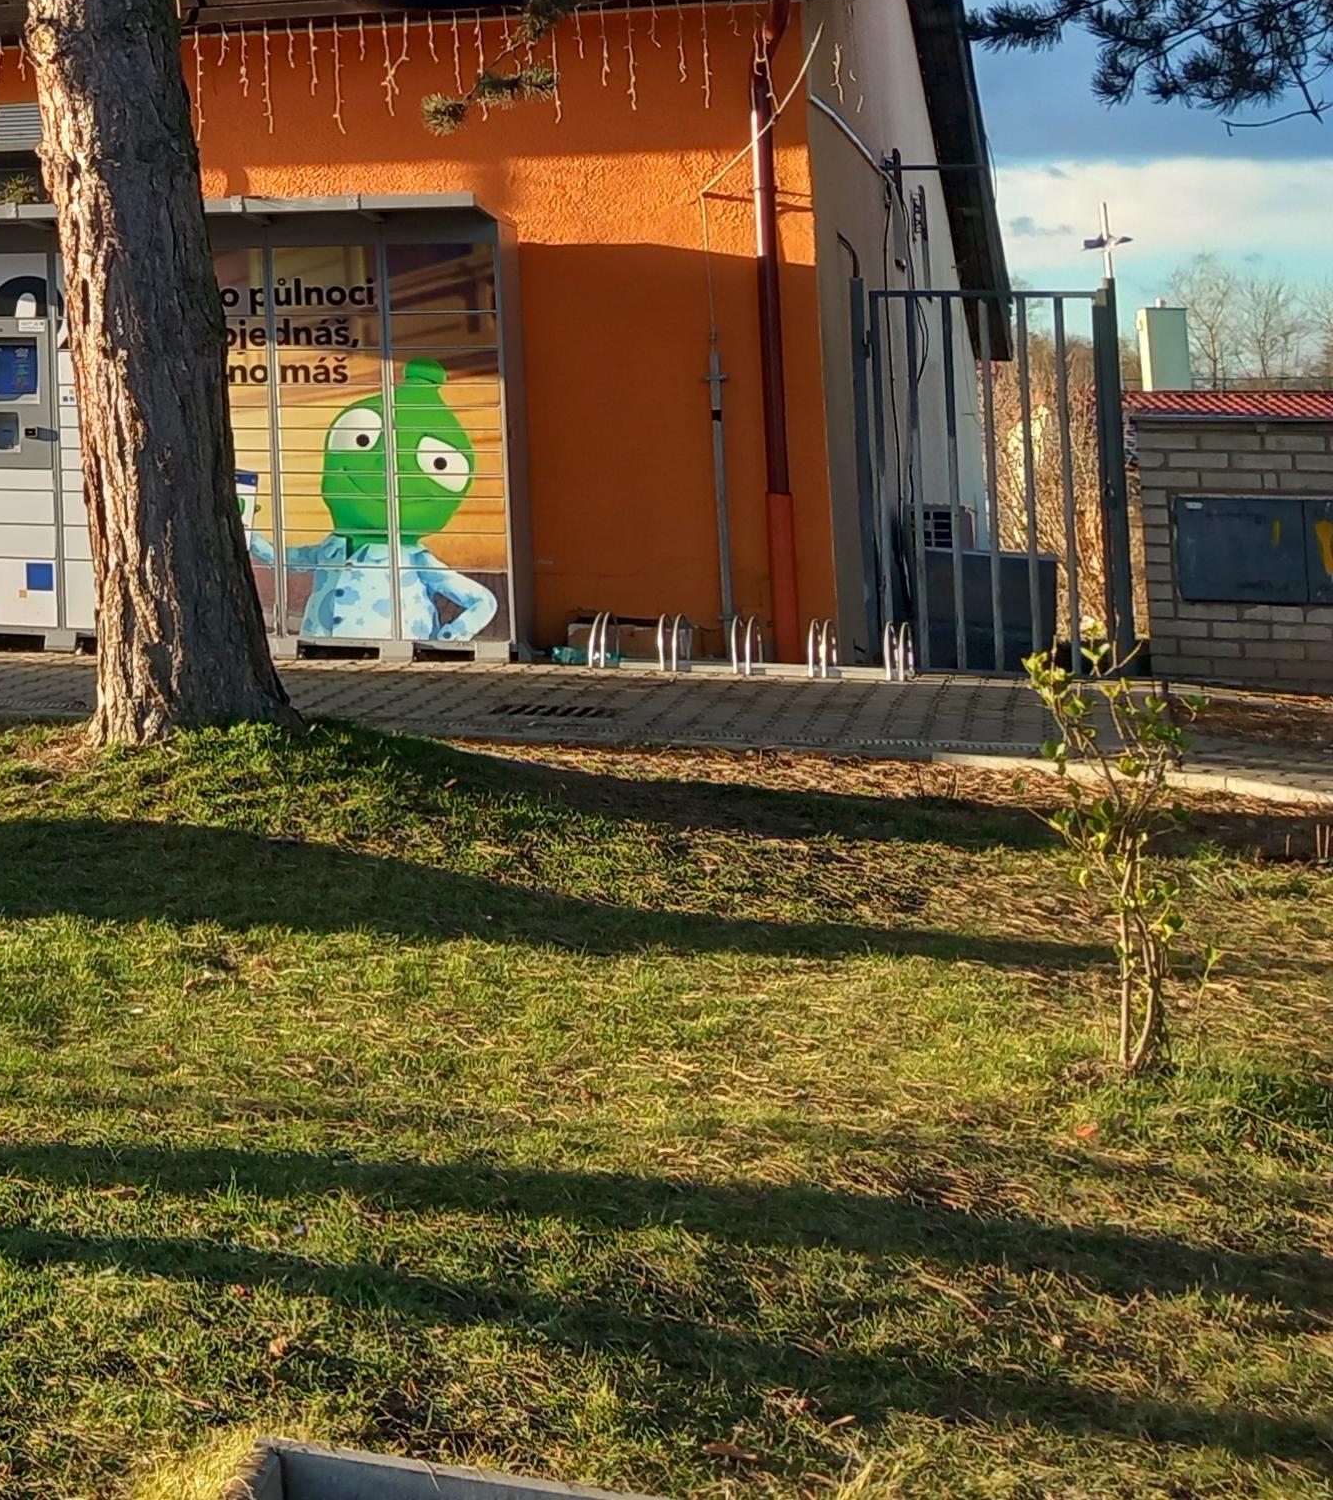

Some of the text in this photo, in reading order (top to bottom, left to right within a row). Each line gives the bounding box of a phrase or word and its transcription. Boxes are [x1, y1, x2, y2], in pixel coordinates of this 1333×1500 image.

[249, 277, 374, 315] půlnoci
[225, 318, 360, 354] jednáš,
[280, 356, 349, 383] máš
